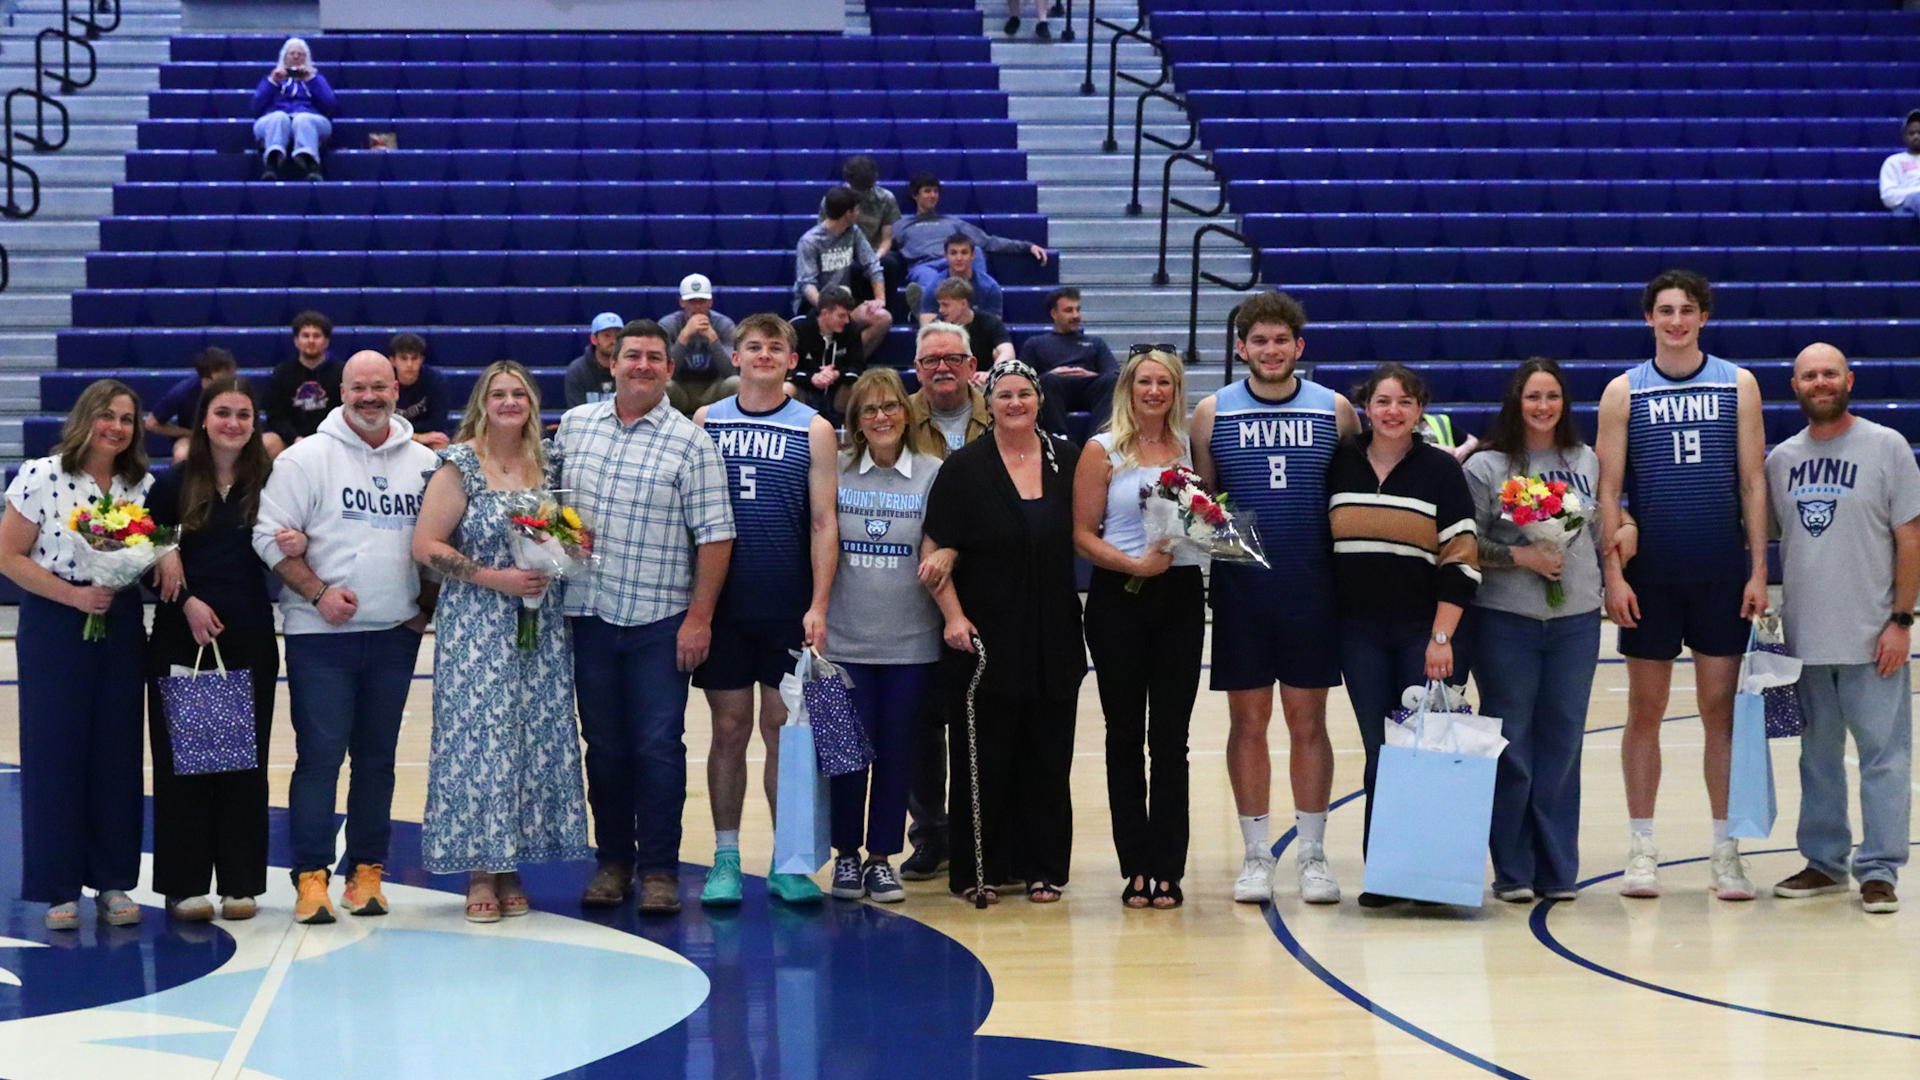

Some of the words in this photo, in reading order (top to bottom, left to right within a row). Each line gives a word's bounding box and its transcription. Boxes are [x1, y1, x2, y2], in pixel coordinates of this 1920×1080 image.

[1648, 395, 1719, 424] MVNU
[719, 430, 787, 460] MVNU
[1239, 420, 1313, 448] MVNU
[1671, 430, 1701, 464] 19
[739, 466, 756, 499] 5
[1267, 456, 1287, 488] 8
[1788, 458, 1857, 492] MVNU
[838, 487, 876, 507] MOUNT
[879, 491, 922, 510] VERNON
[838, 505, 874, 516] AZARENE
[876, 510, 922, 519] UNIVERSITY
[843, 542, 908, 554] VOLLEYBALL
[849, 554, 899, 568] BUSH
